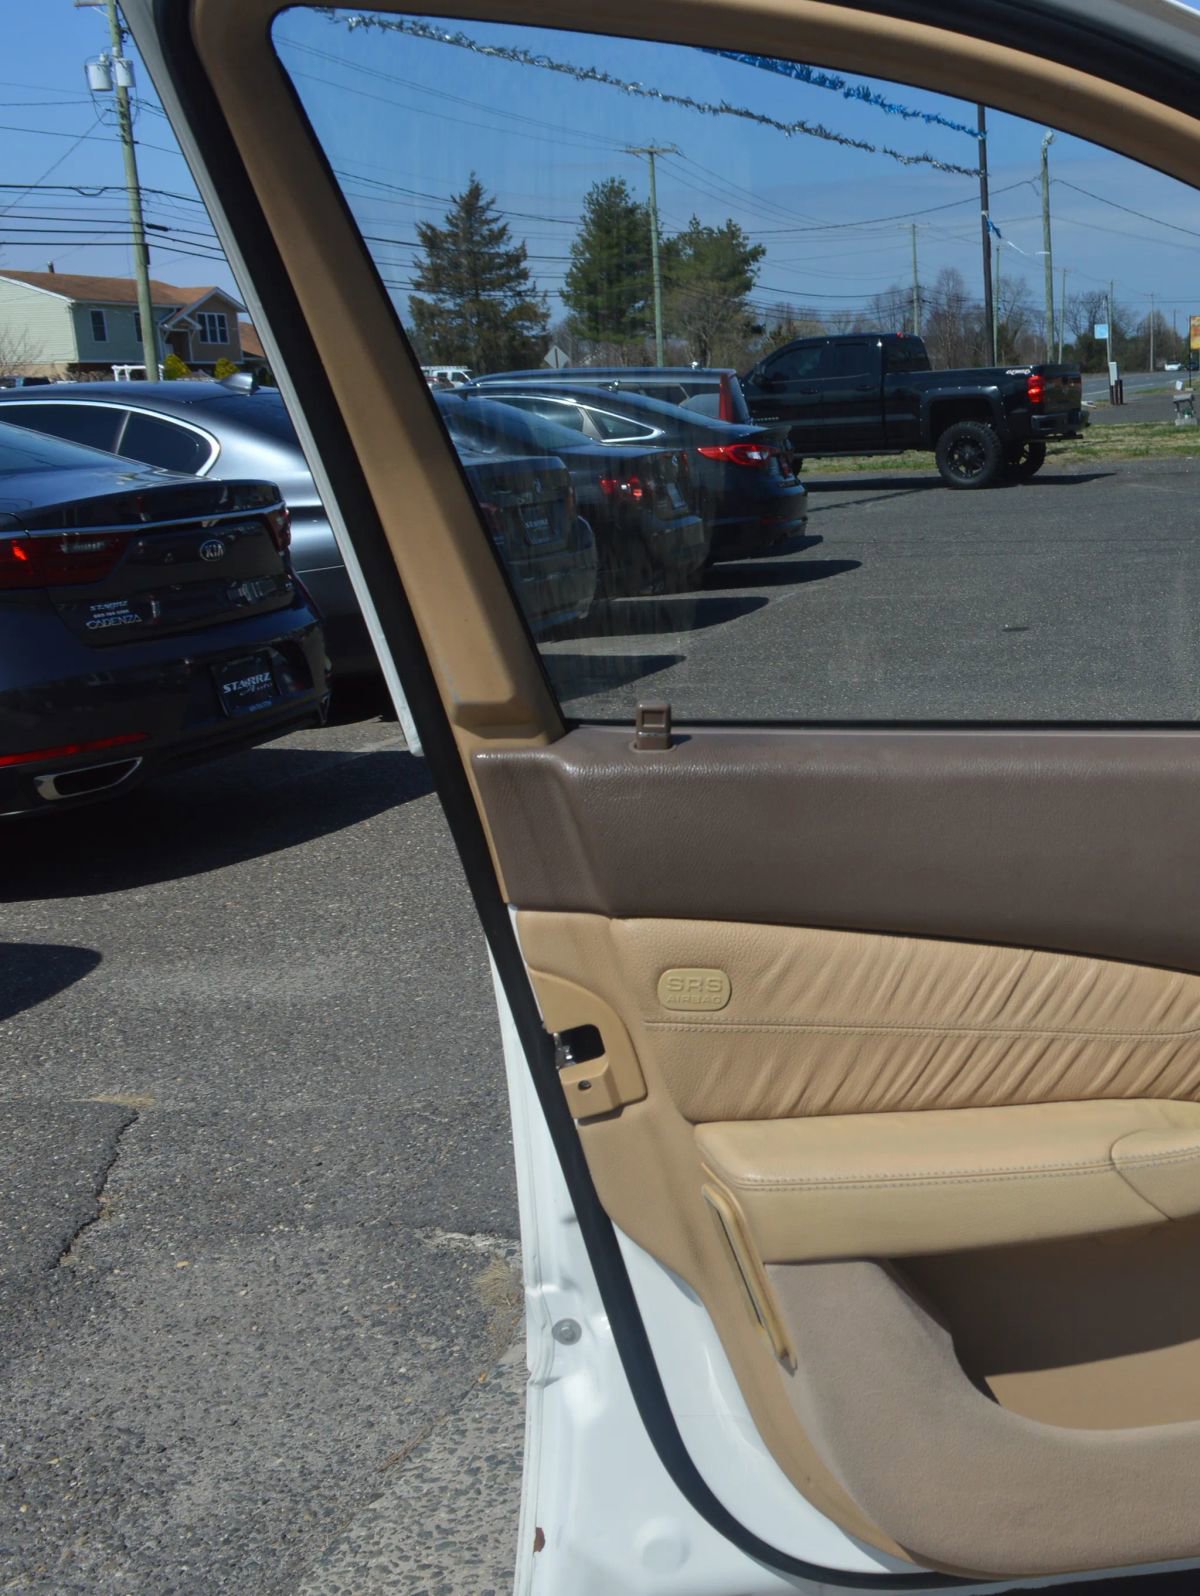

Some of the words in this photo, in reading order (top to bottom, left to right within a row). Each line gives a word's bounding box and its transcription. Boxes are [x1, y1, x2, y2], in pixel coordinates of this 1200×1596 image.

[85, 613, 143, 630] CADENZA
[223, 672, 272, 694] STARRZ
[666, 977, 723, 993] SRS
